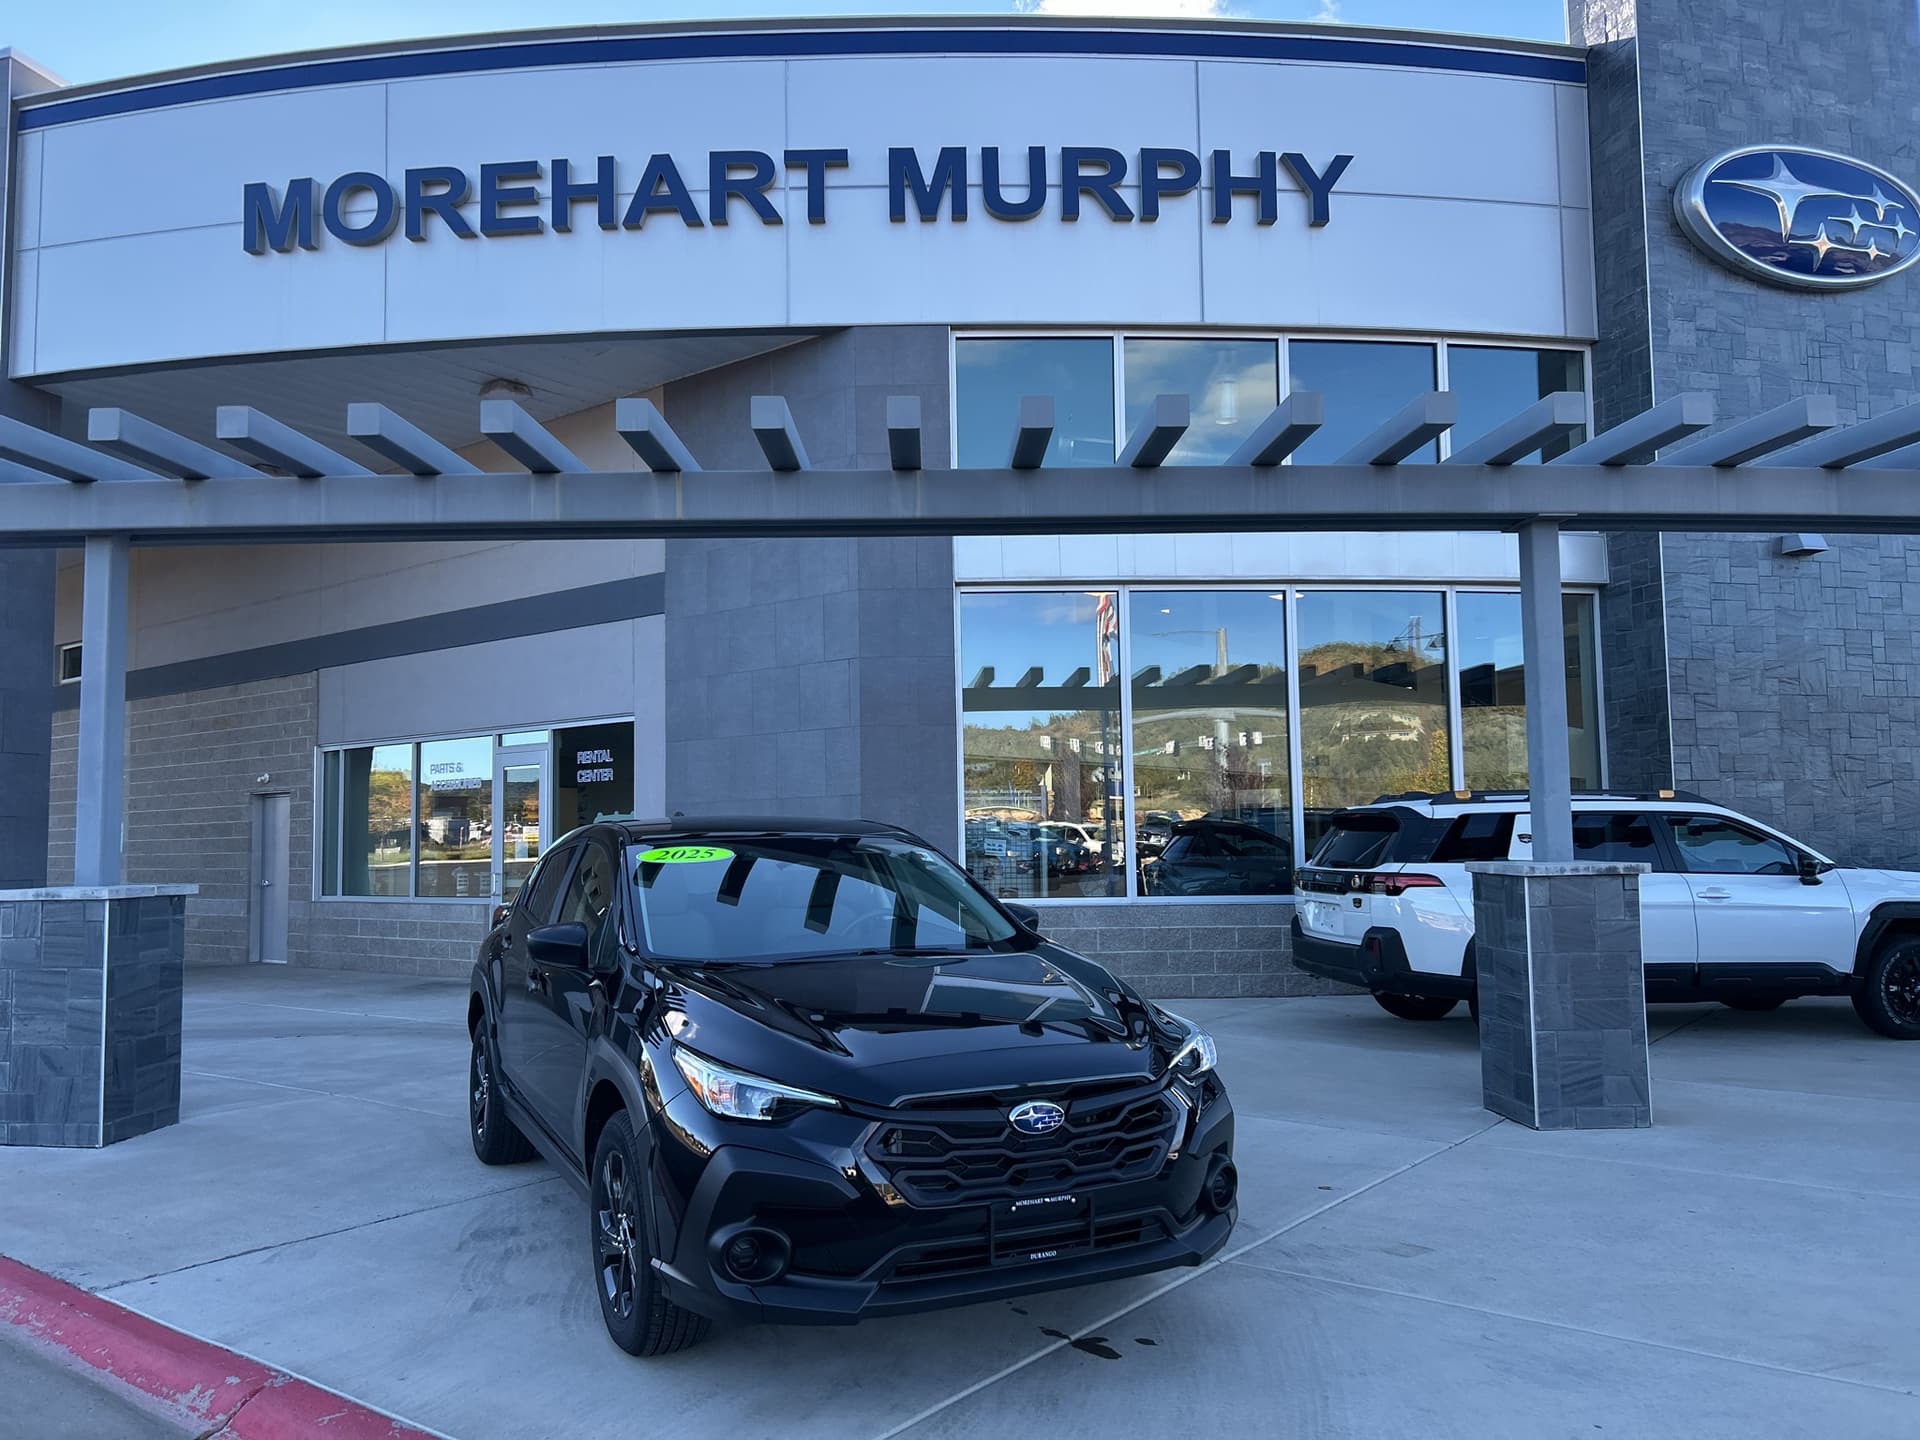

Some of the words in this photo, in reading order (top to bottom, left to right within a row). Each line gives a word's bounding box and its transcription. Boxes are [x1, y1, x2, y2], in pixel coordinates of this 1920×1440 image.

[243, 149, 849, 256] MOREHART
[888, 145, 1354, 227] MURPHY
[577, 749, 614, 764] RENTAL
[430, 762, 455, 774] PARTS
[456, 761, 464, 773] &
[577, 768, 614, 783] CENTER
[655, 848, 717, 860] 2025
[1030, 1250, 1057, 1260] DURANGO
